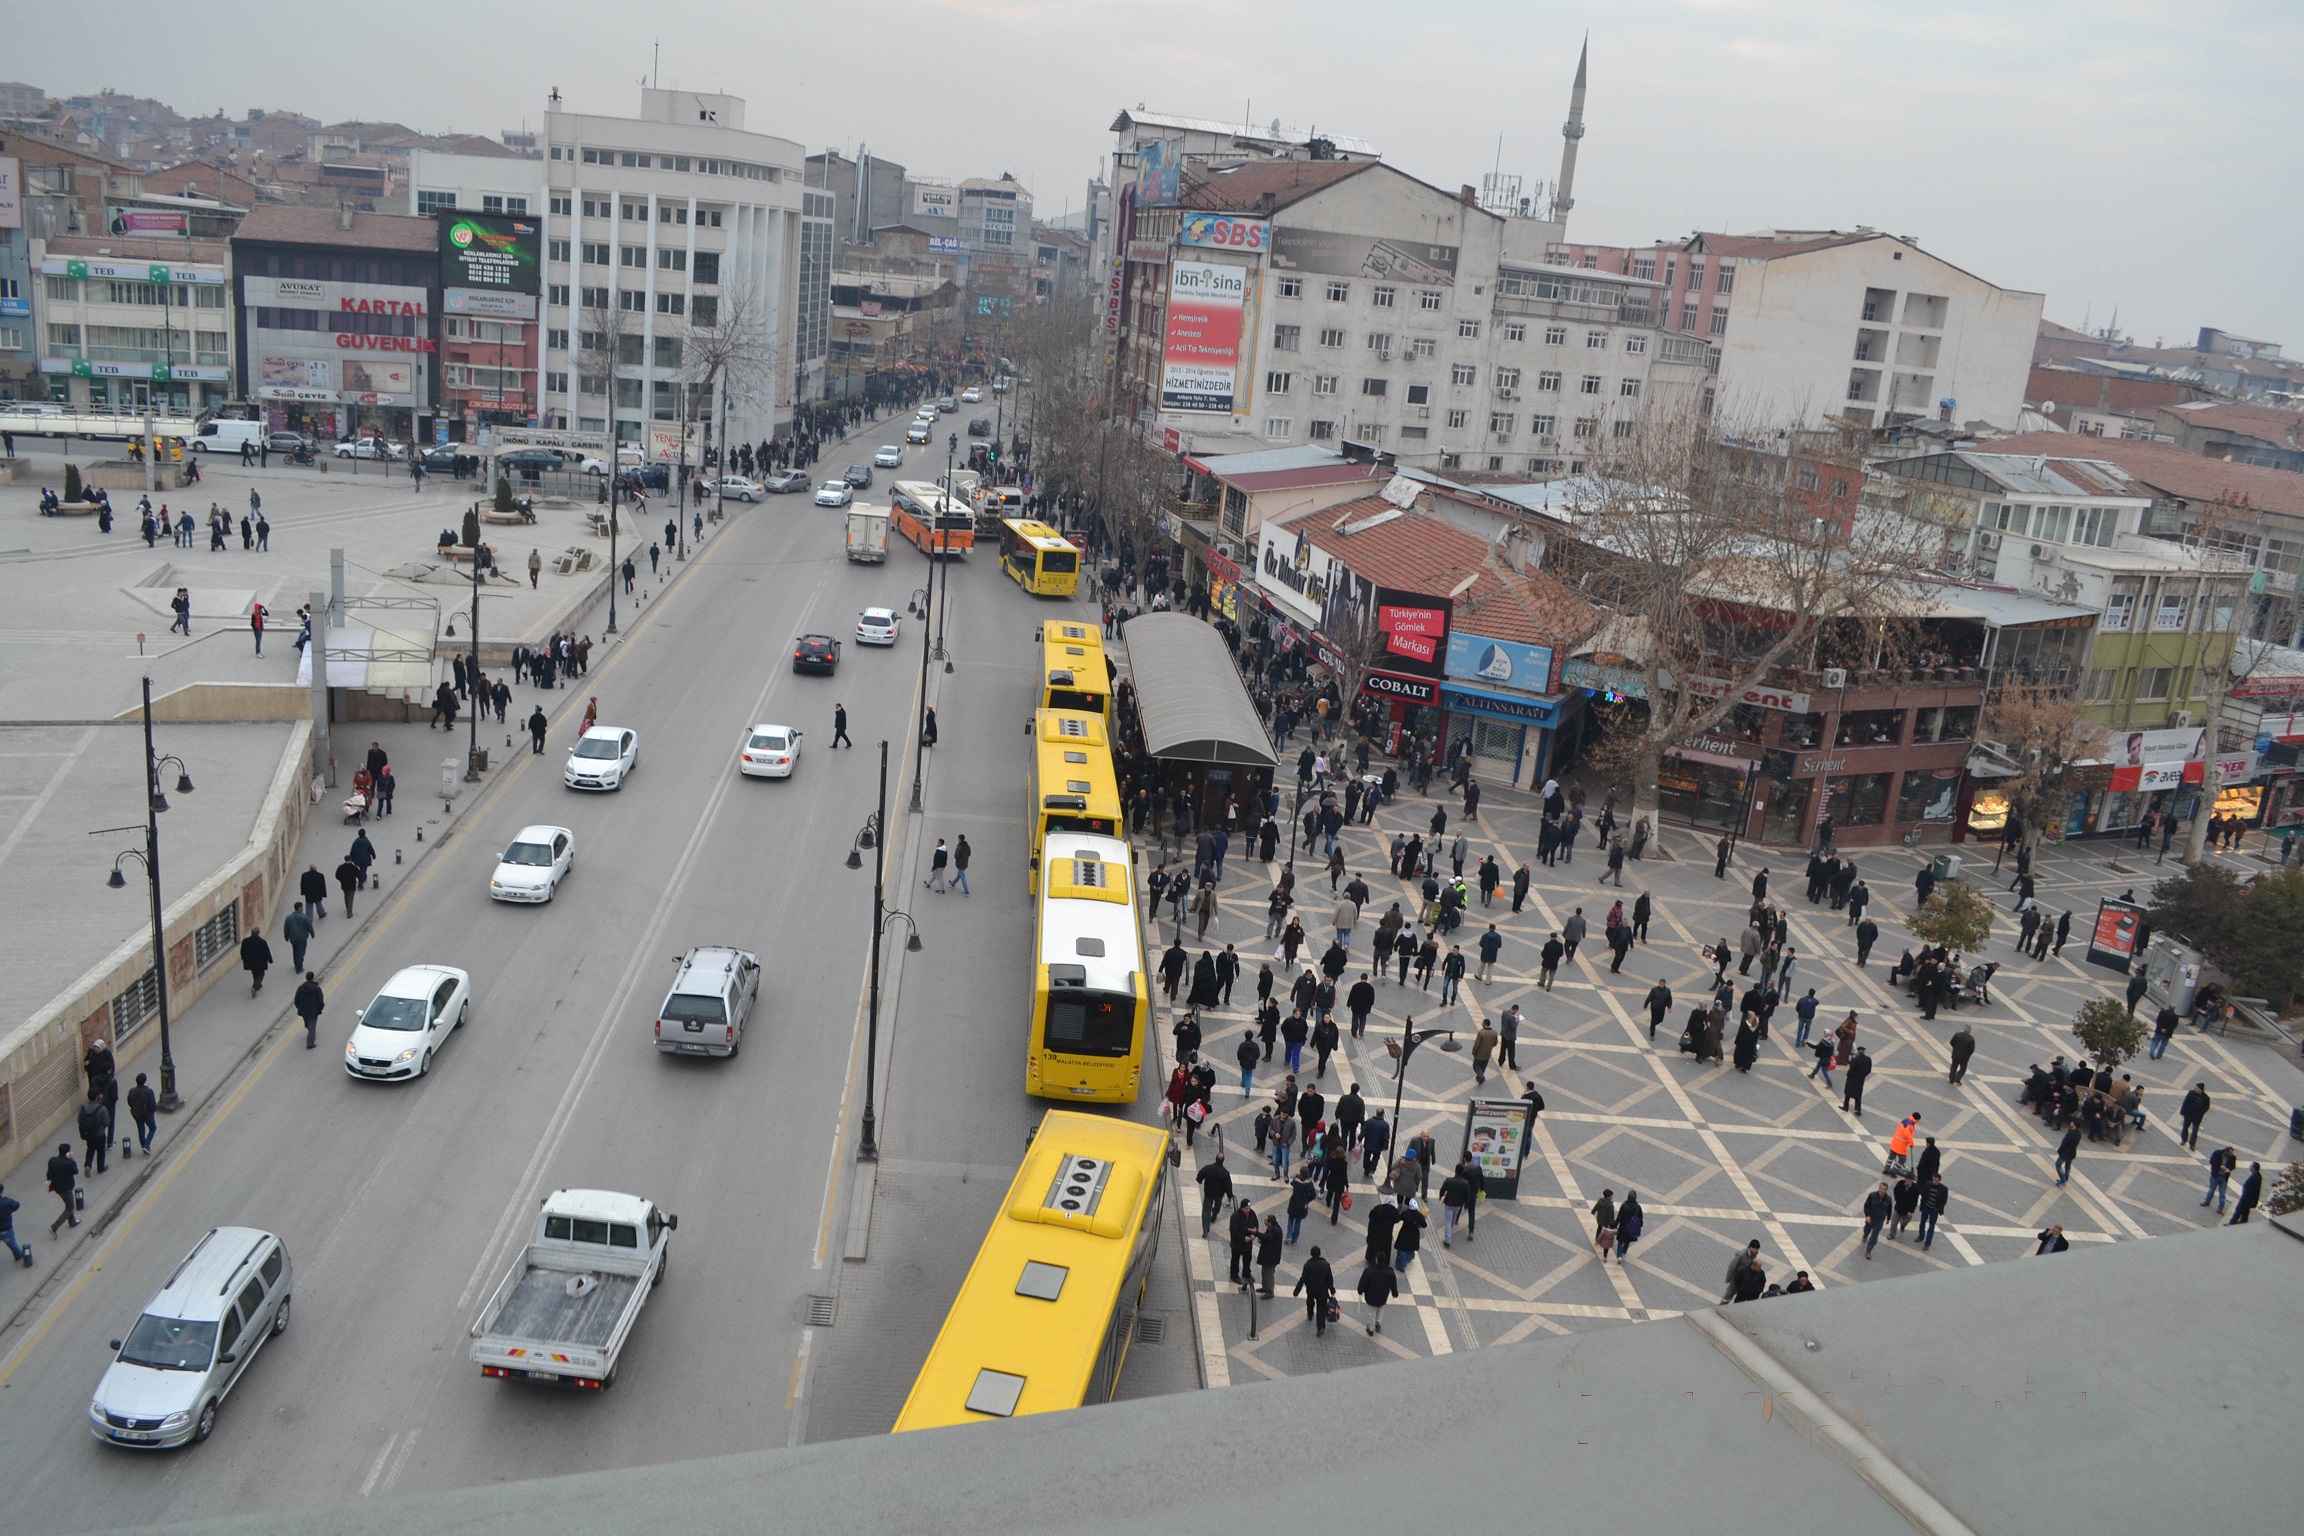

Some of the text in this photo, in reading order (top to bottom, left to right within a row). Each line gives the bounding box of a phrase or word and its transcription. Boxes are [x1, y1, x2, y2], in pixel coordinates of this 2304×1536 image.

[1213, 219, 1262, 248] SBS
[93, 267, 115, 276] TEB
[175, 272, 197, 280] TEB
[280, 283, 321, 291] AVUKAT
[1213, 274, 1241, 290] sina
[341, 297, 427, 317] KARTAL
[336, 333, 437, 353] GÜVENLİK
[1176, 344, 1187, 352] Acil
[98, 365, 119, 374] TEB
[177, 369, 198, 377] TEB
[1165, 376, 1231, 391] HİZMETİNİZDEDİR
[502, 436, 529, 445] İNÖNÜ
[1390, 608, 1431, 620] Türkiye'nin
[1395, 622, 1425, 632] Gömlek
[1393, 635, 1430, 655] Markası
[1369, 677, 1429, 697] COBALT
[1684, 735, 1738, 755] erhent
[2160, 771, 2182, 782] avea
